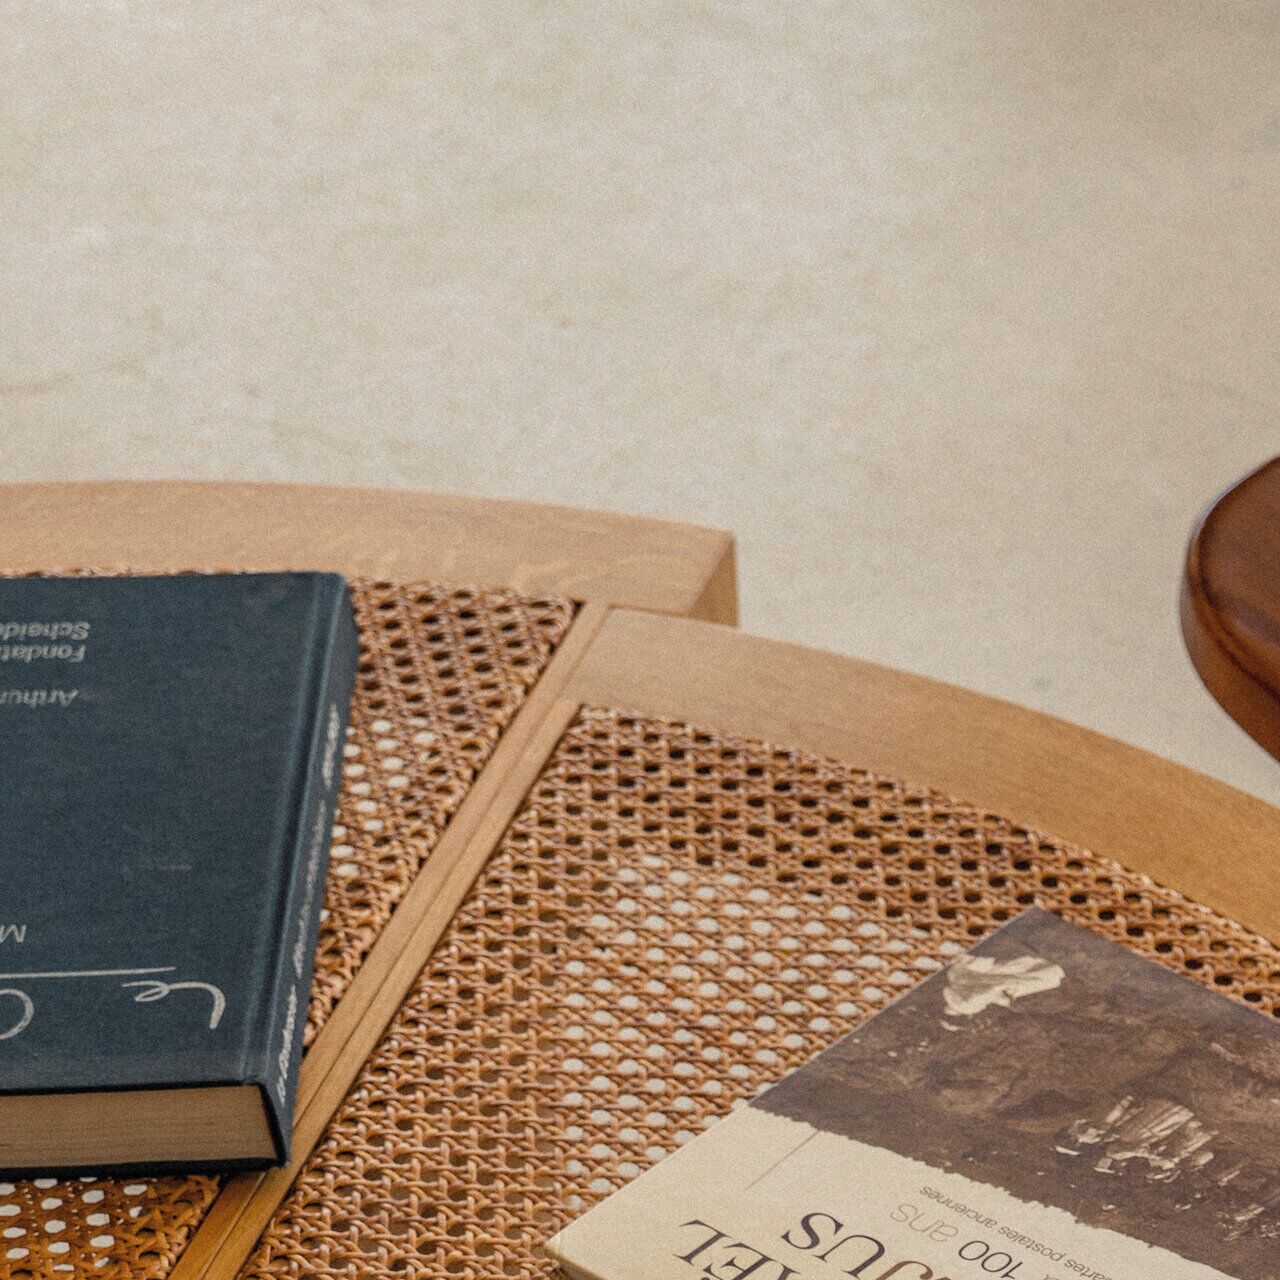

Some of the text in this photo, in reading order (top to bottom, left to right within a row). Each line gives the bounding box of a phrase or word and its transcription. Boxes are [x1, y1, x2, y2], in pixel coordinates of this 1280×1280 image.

[121, 979, 226, 1030] Le
[889, 1203, 960, 1244] ans
[919, 1184, 1005, 1232] anciennes
[957, 1239, 1026, 1280] 100
[998, 1225, 1064, 1262] postales
